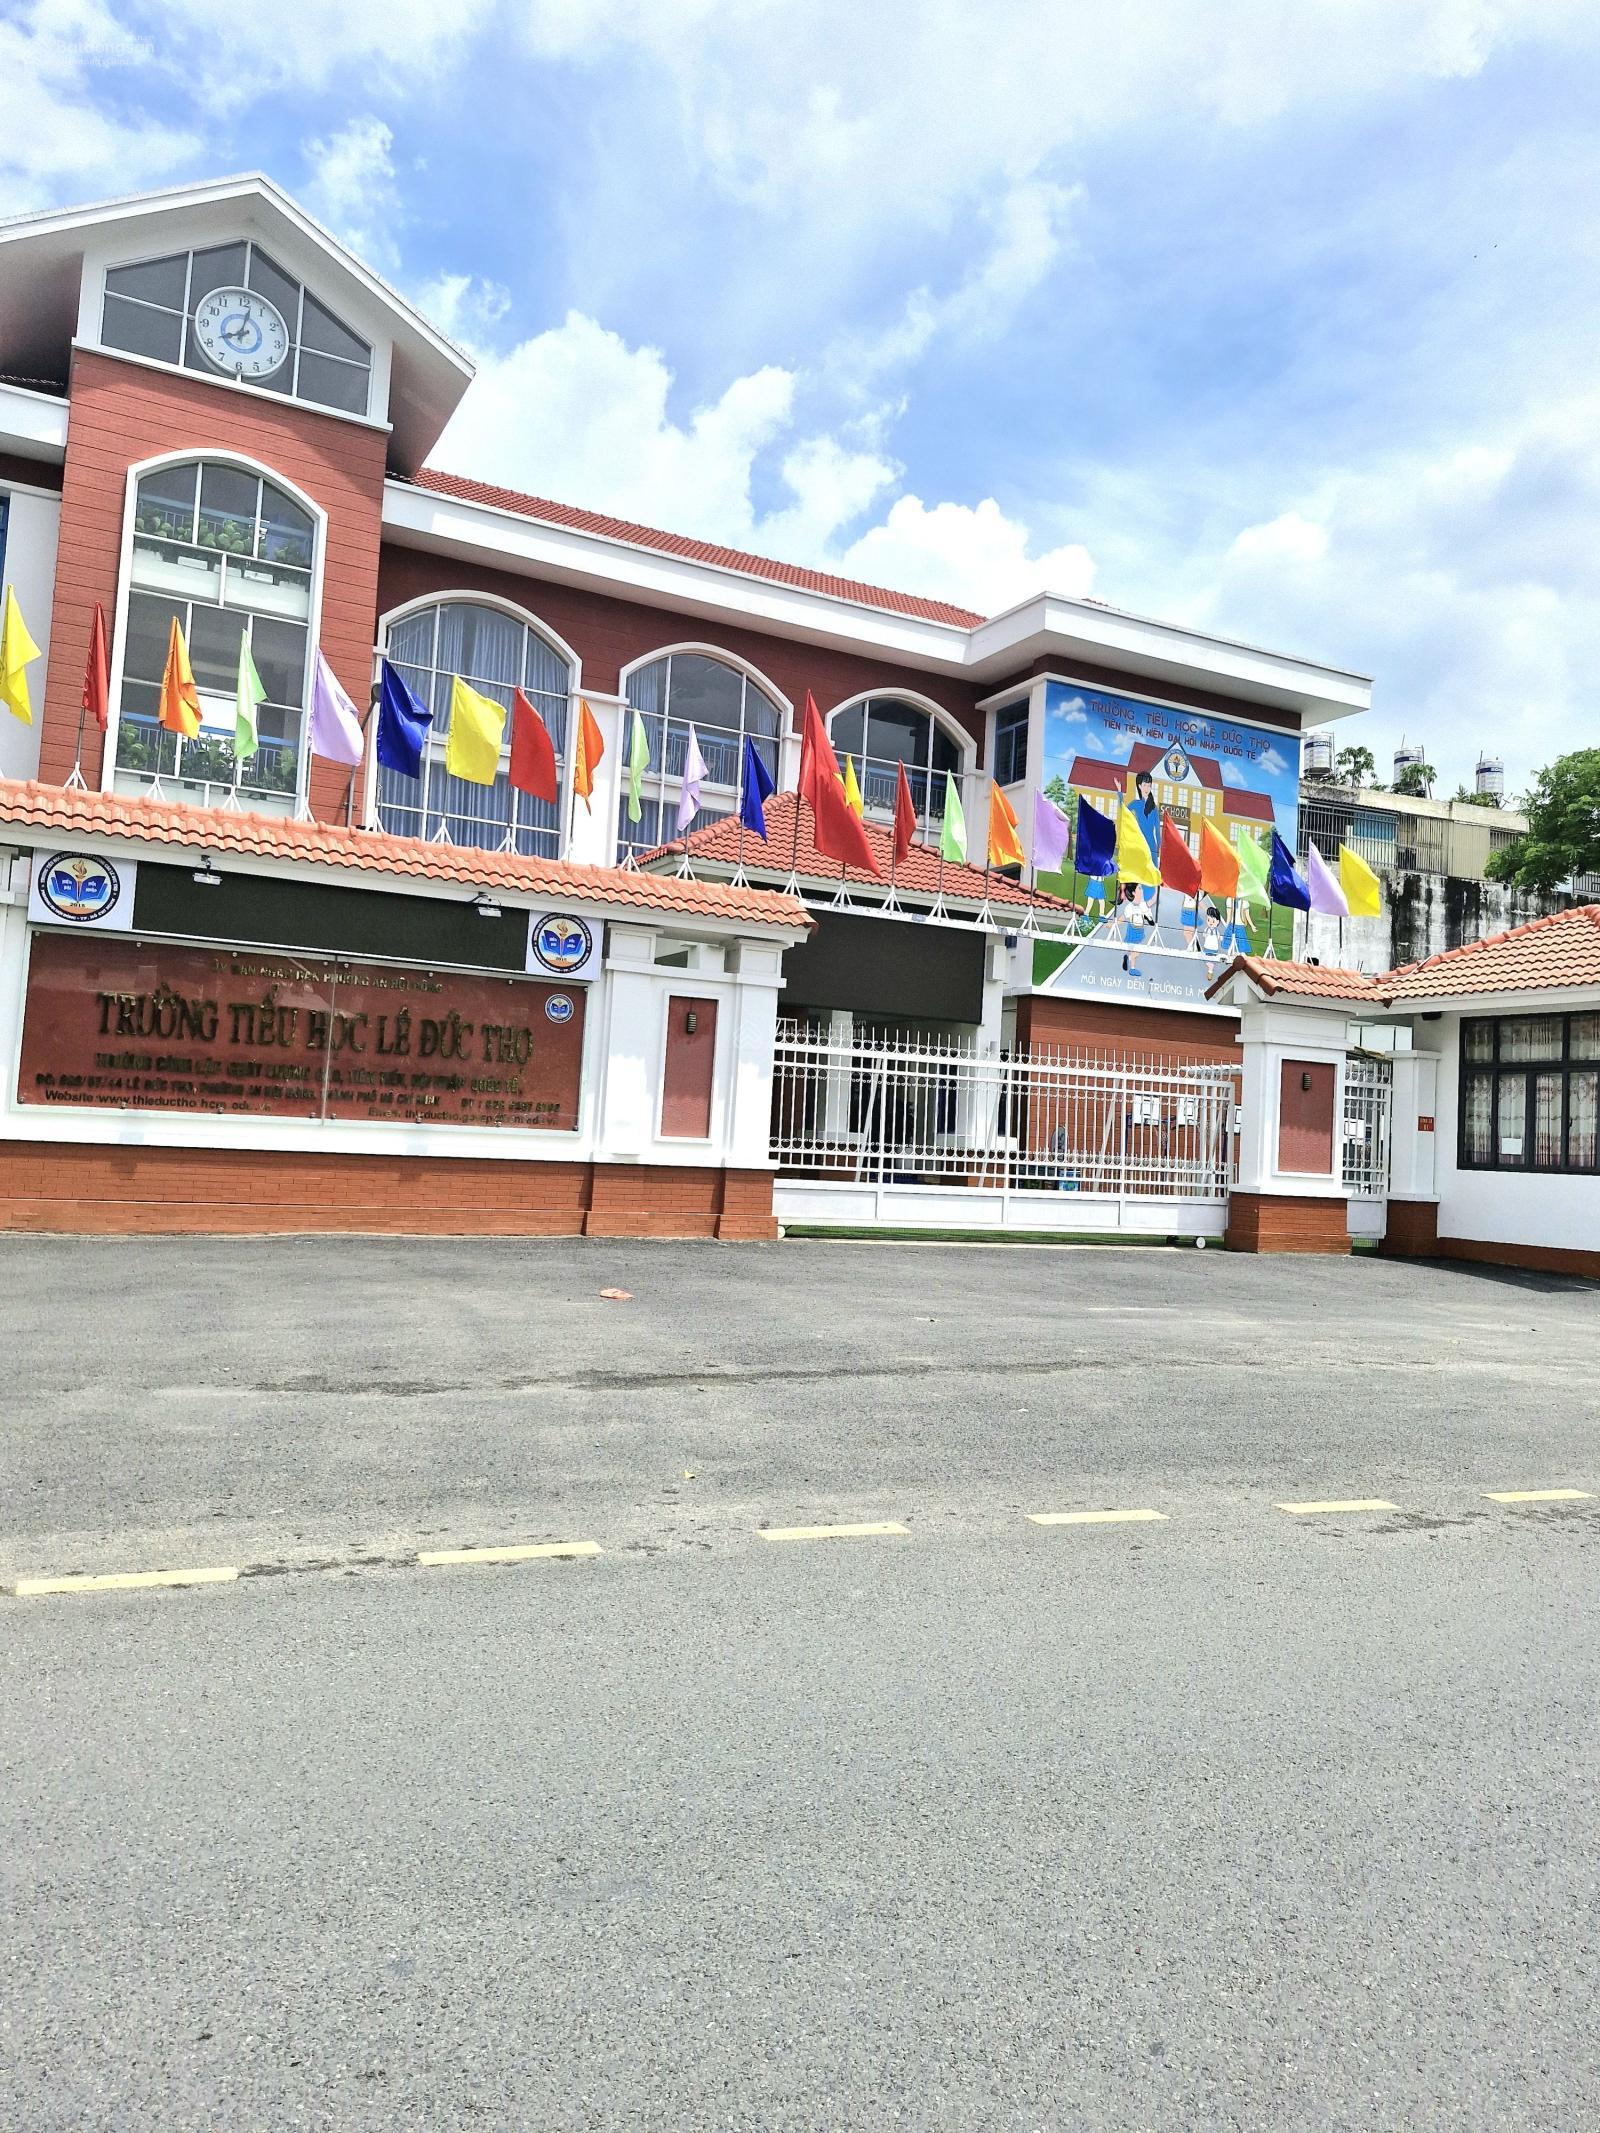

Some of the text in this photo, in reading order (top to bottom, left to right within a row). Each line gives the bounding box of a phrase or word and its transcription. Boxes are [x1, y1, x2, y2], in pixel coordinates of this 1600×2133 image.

[220, 298, 227, 308] 11
[240, 298, 250, 308] 12
[209, 306, 220, 316] 10
[259, 309, 264, 317] 1
[202, 319, 209, 328] 9
[269, 322, 276, 332] 2
[206, 339, 214, 348] 8
[274, 340, 281, 349] 3
[219, 352, 225, 361] 7
[266, 356, 273, 365] 4
[236, 362, 243, 370] 6
[253, 362, 260, 372] 5
[1175, 720, 1198, 735] HỌC
[1203, 721, 1216, 737] LÊ
[1249, 736, 1271, 753] THỌ
[97, 981, 535, 1072] TRƯỜNG TIỂU HỌC LÊ ĐỨC THỌ
